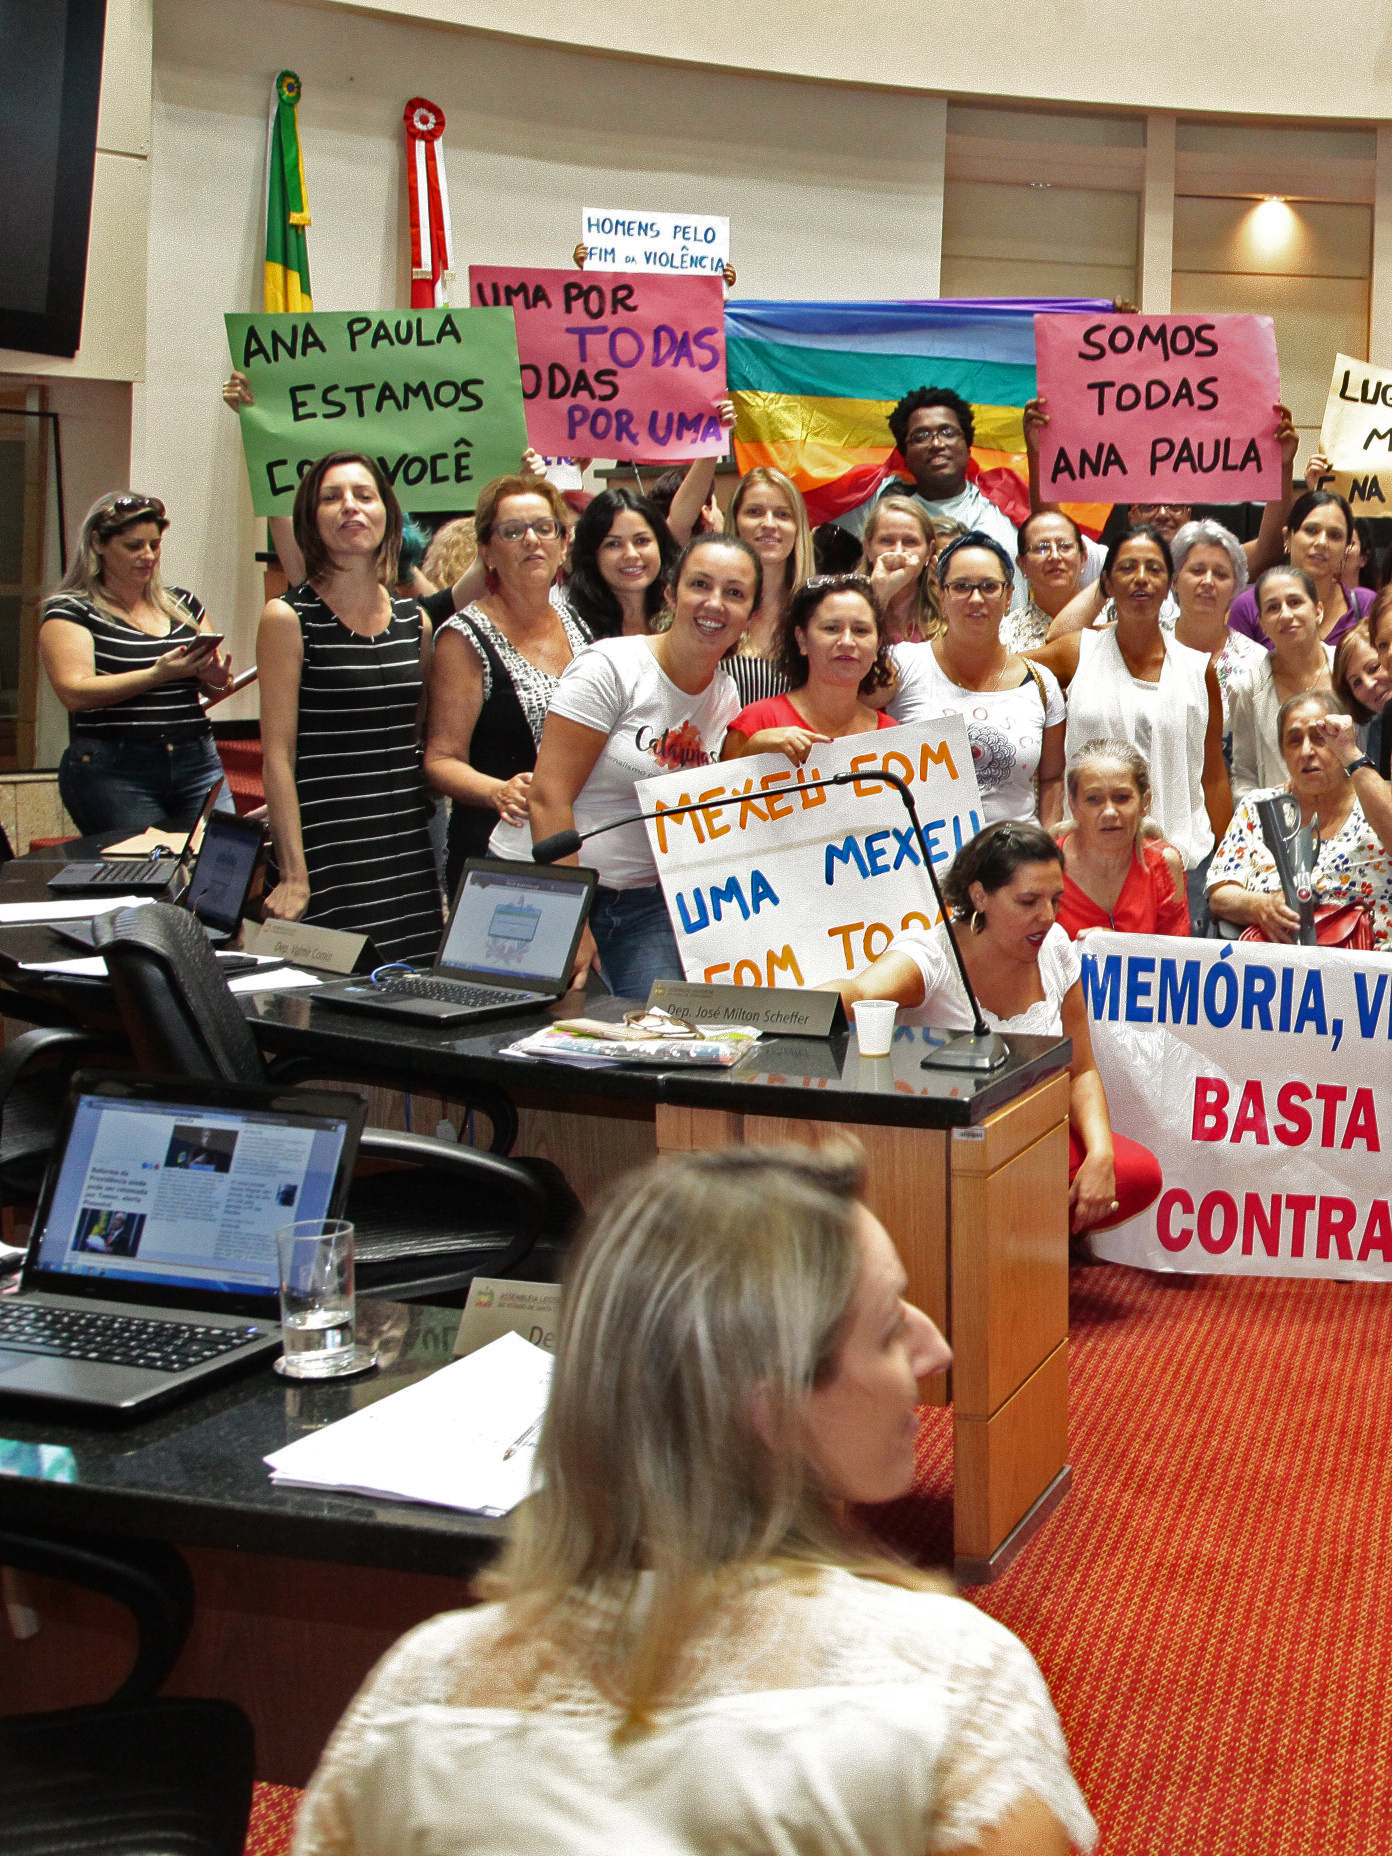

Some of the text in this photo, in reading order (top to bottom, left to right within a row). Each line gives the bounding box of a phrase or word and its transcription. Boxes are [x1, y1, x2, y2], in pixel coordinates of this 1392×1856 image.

[587, 217, 716, 244] HOMENS PELO
[587, 246, 616, 264] FIM
[644, 246, 726, 272] VIOLÊNCIA
[477, 282, 638, 320] UMA POR
[244, 314, 462, 368] ANA PAULA
[565, 325, 720, 372] TODAS
[1078, 323, 1219, 361] SOMOS
[289, 379, 485, 421] ESTAMOS
[519, 362, 620, 401] ODAS
[1087, 376, 1219, 415] TODAS
[567, 404, 722, 446] POR UMA
[376, 437, 473, 486] VOCÊ
[1051, 437, 1263, 484] ANA PAULA
[1348, 474, 1386, 504] NA
[655, 767, 827, 854] MEXEU
[676, 810, 981, 935] UMA MEXEU
[695, 1004, 720, 1019] José
[723, 1006, 760, 1022] Milton
[764, 1009, 810, 1025] Scheffer
[1080, 944, 1343, 1051] MEMÓRIA,
[1191, 1076, 1381, 1152] BASTA
